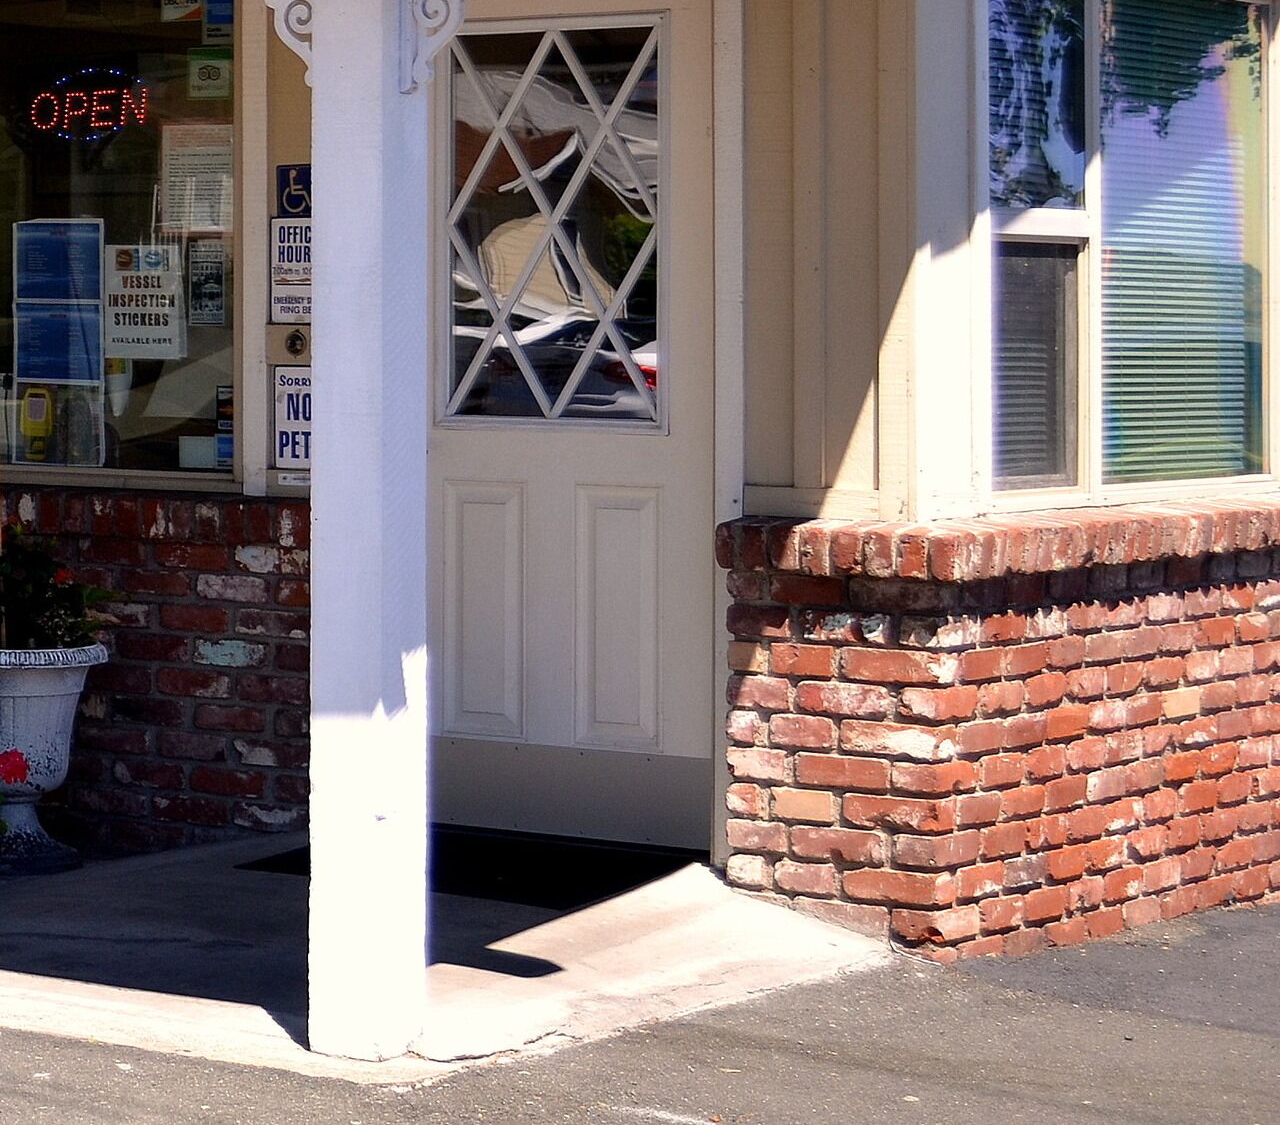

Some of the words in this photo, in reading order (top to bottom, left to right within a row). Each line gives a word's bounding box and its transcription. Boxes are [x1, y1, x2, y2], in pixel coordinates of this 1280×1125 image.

[30, 86, 147, 130] OPEN
[278, 225, 311, 243] OFFIC
[278, 245, 311, 263] HOUR
[122, 275, 162, 289] VESSEL
[108, 294, 175, 307] INSPECTION
[280, 305, 300, 314] RING
[113, 312, 169, 327] STICKERS
[112, 337, 149, 345] AVAILABLE
[287, 393, 311, 421] NO
[279, 431, 311, 459] PET
